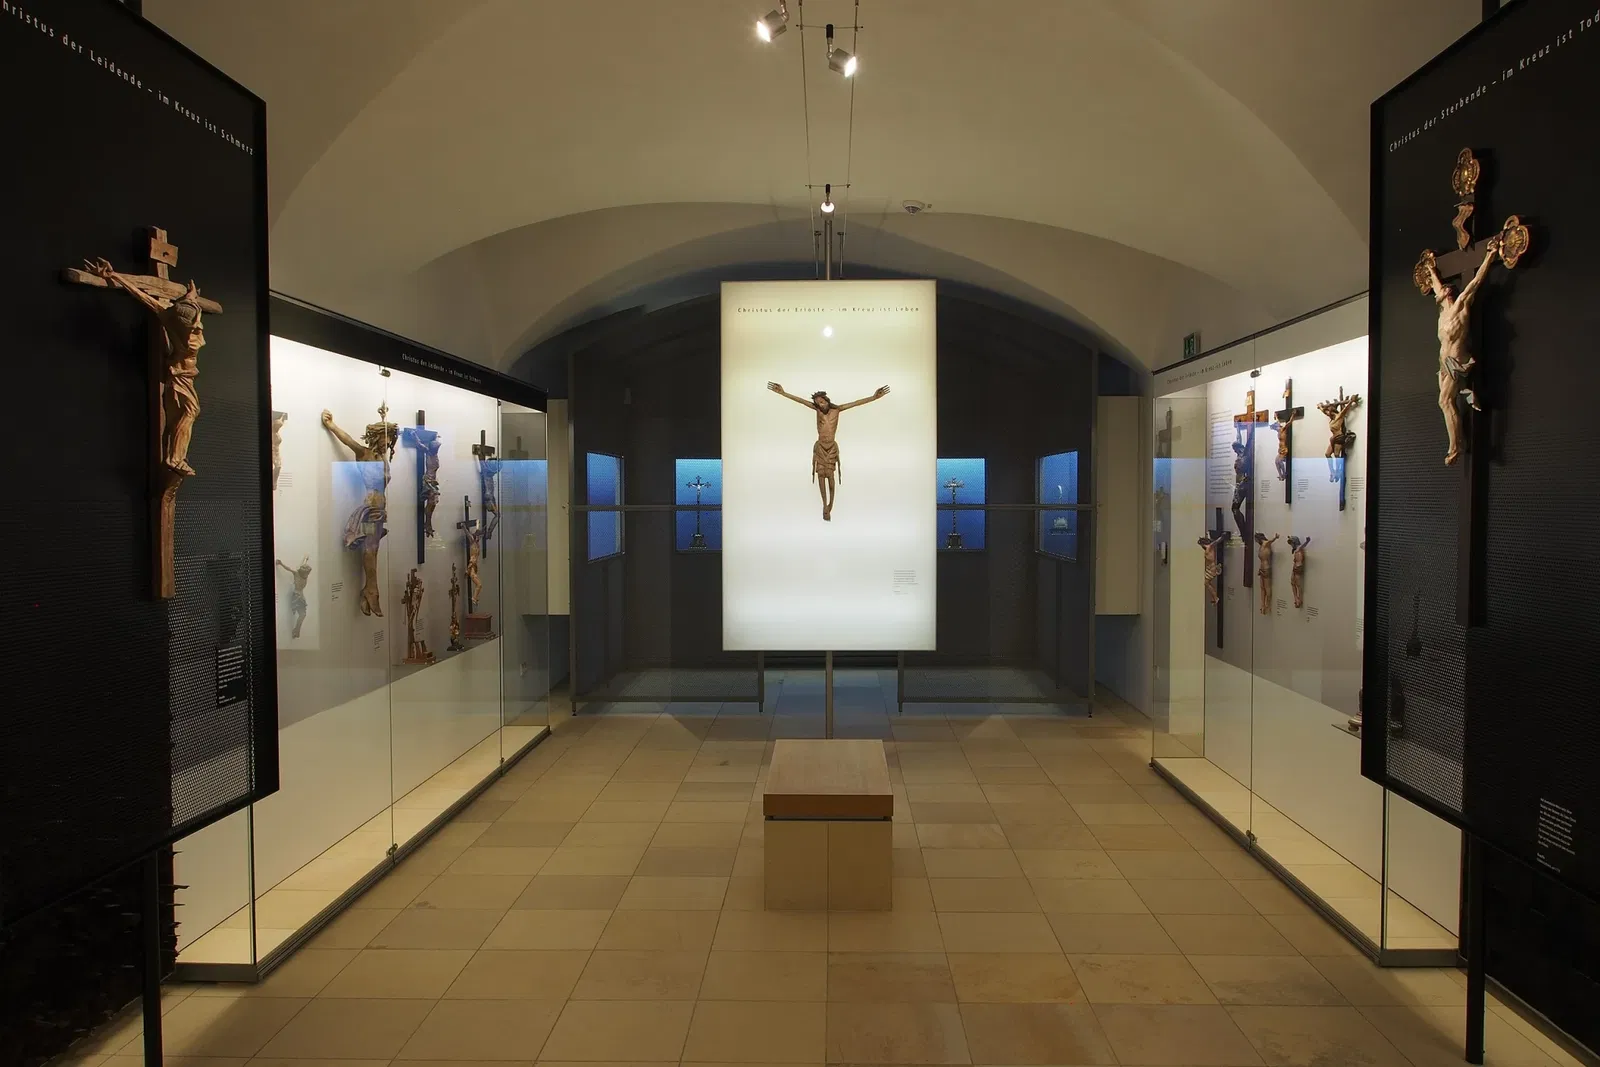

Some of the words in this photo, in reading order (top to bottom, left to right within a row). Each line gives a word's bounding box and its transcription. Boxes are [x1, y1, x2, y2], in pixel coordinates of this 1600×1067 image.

[3, 0, 54, 38] hristus
[63, 34, 83, 54] der
[90, 50, 142, 89] Leidende
[158, 90, 169, 105] im
[175, 101, 200, 124] Kreuz
[205, 118, 217, 134] ist
[221, 129, 253, 156] Schmerz
[1389, 126, 1420, 153] Christus
[1424, 117, 1437, 131] der
[1441, 84, 1487, 120] Sterbende
[1502, 67, 1514, 81] im
[1519, 44, 1550, 70] Kreuz
[1557, 29, 1573, 47] ist
[1580, 9, 1600, 32] Tod
